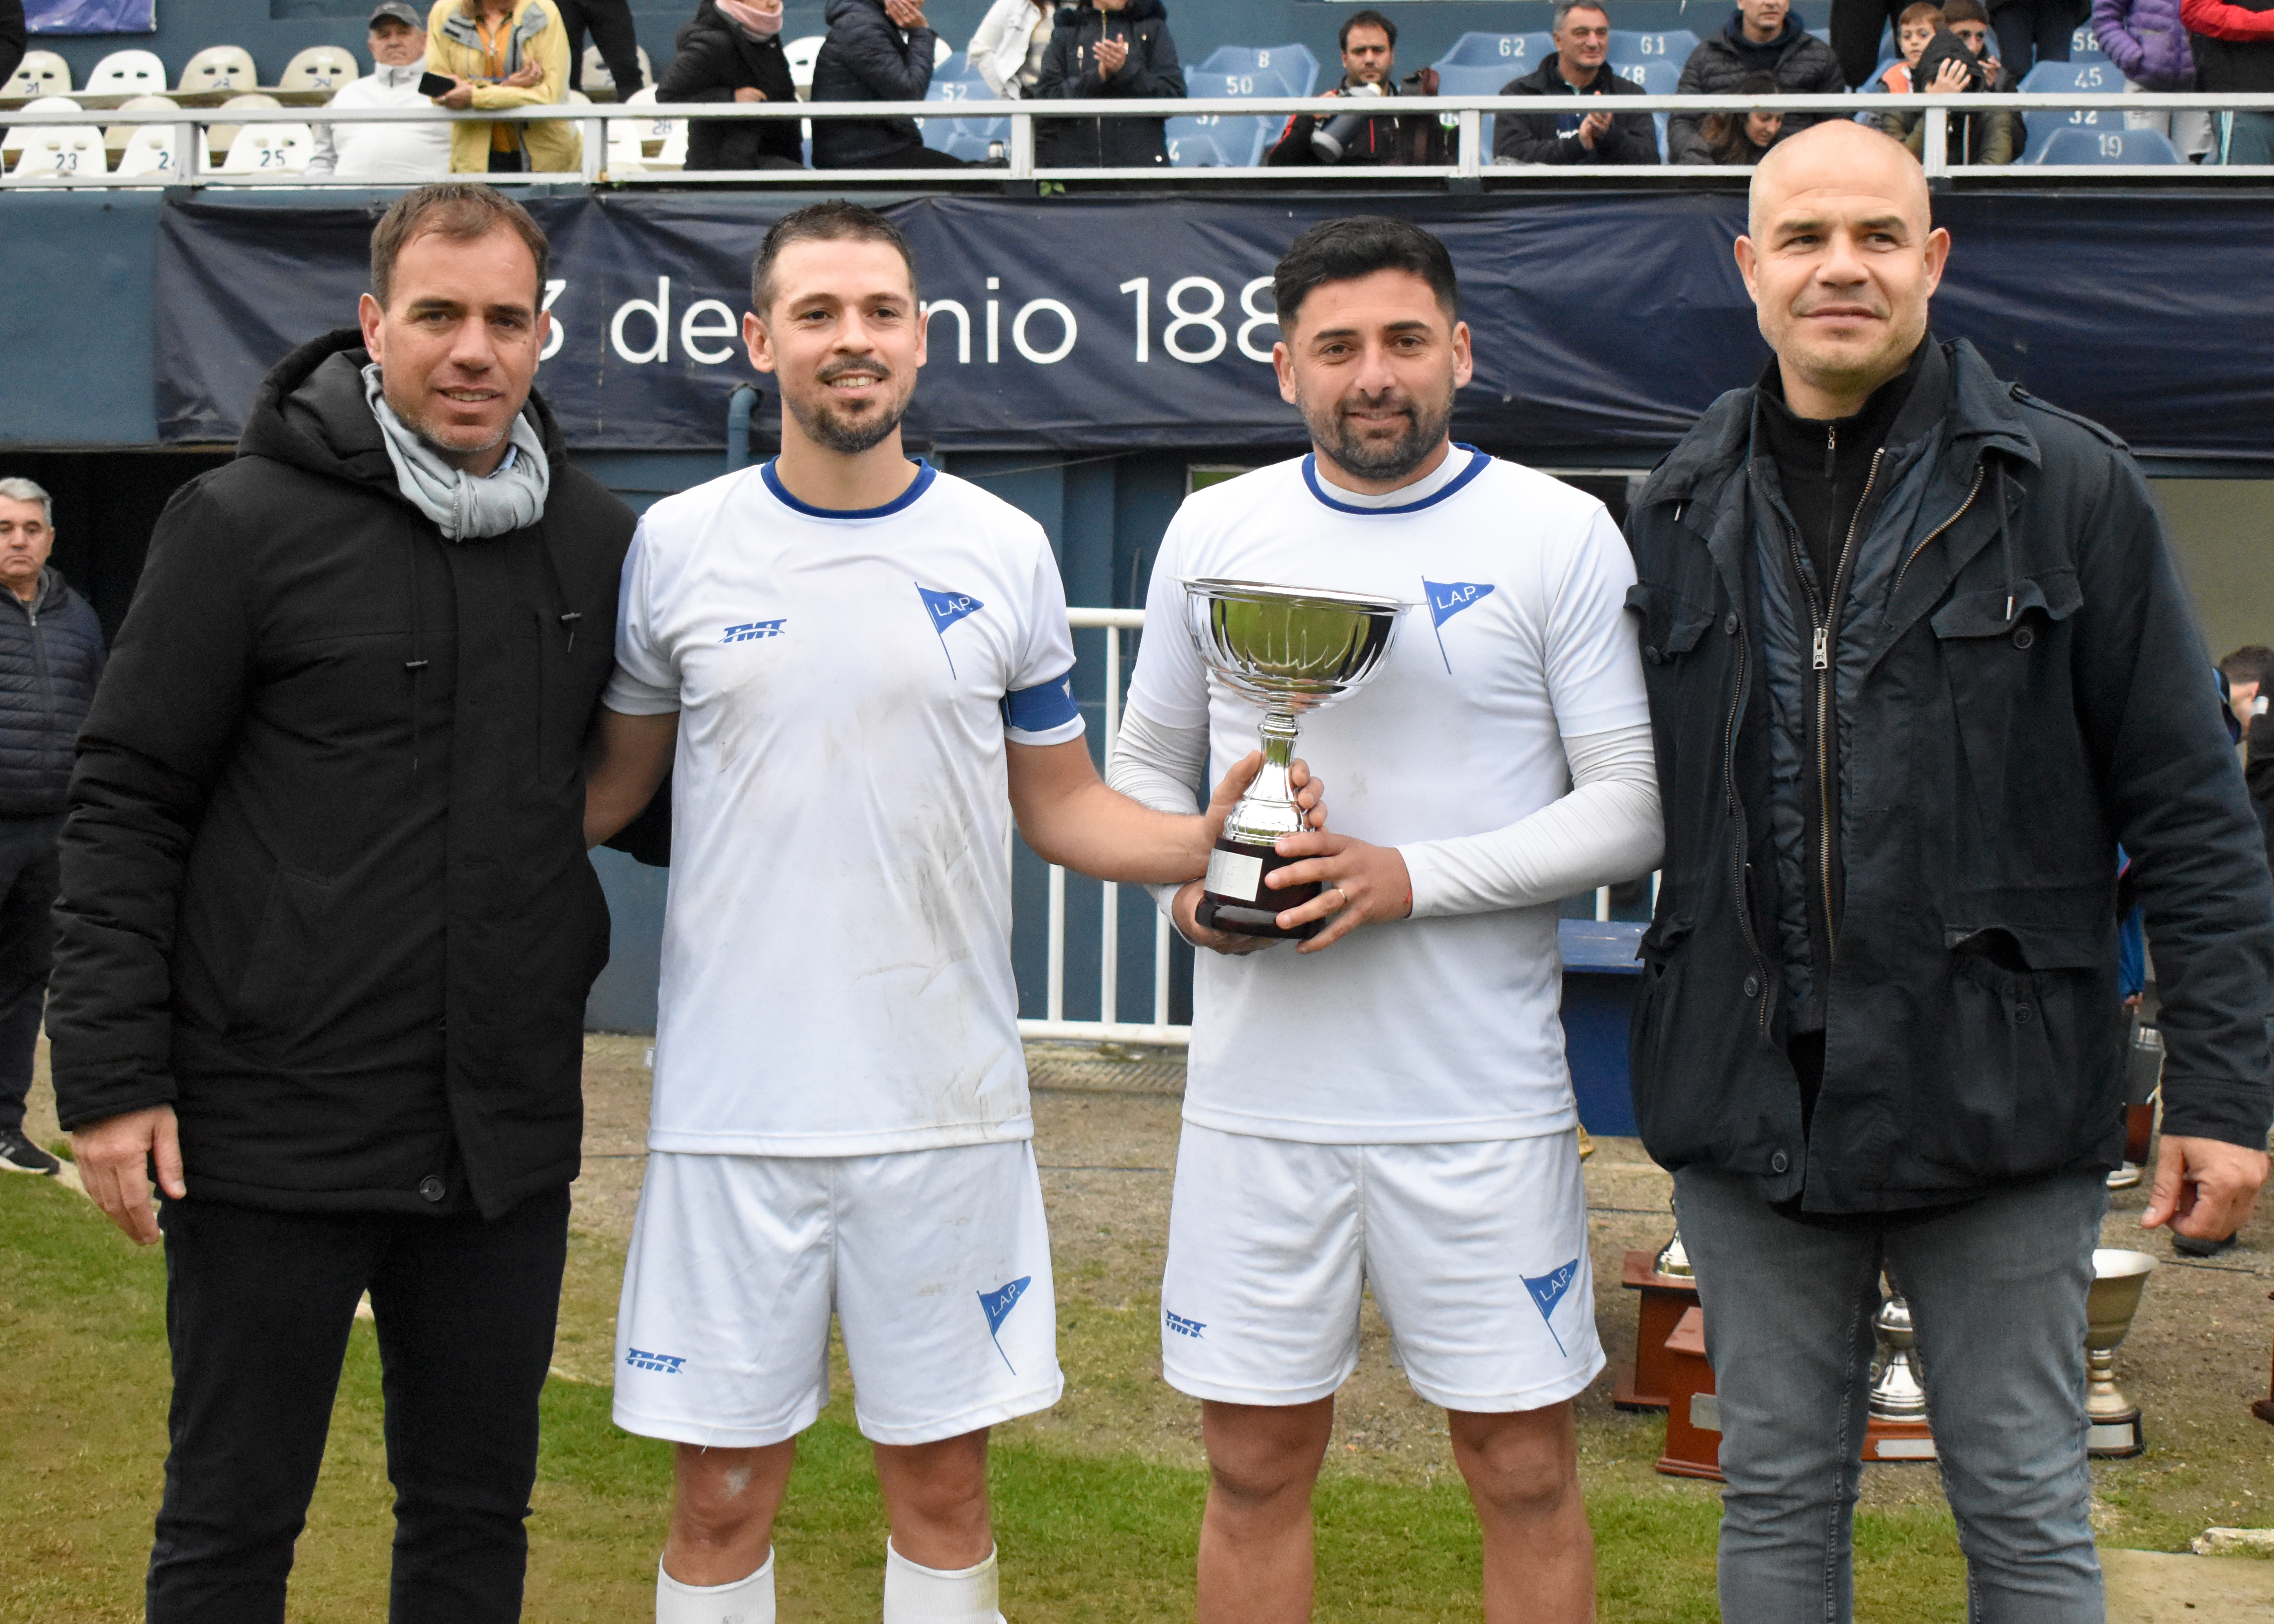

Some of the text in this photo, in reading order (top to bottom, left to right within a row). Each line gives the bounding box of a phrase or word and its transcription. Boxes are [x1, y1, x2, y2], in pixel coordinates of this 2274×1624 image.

[1500, 37, 1525, 57] 62
[1641, 35, 1665, 55] 61
[942, 82, 967, 102] 52
[1226, 75, 1253, 95] 50
[2099, 133, 2123, 159] 19
[56, 152, 77, 170] 23
[159, 151, 175, 169] 2
[260, 149, 286, 167] 25
[611, 276, 738, 364] de
[919, 277, 1078, 364] nio
[1119, 276, 1279, 364] 188
[718, 619, 787, 643] TMT
[1165, 1309, 1207, 1339] TMT
[625, 1347, 686, 1374] TMT
